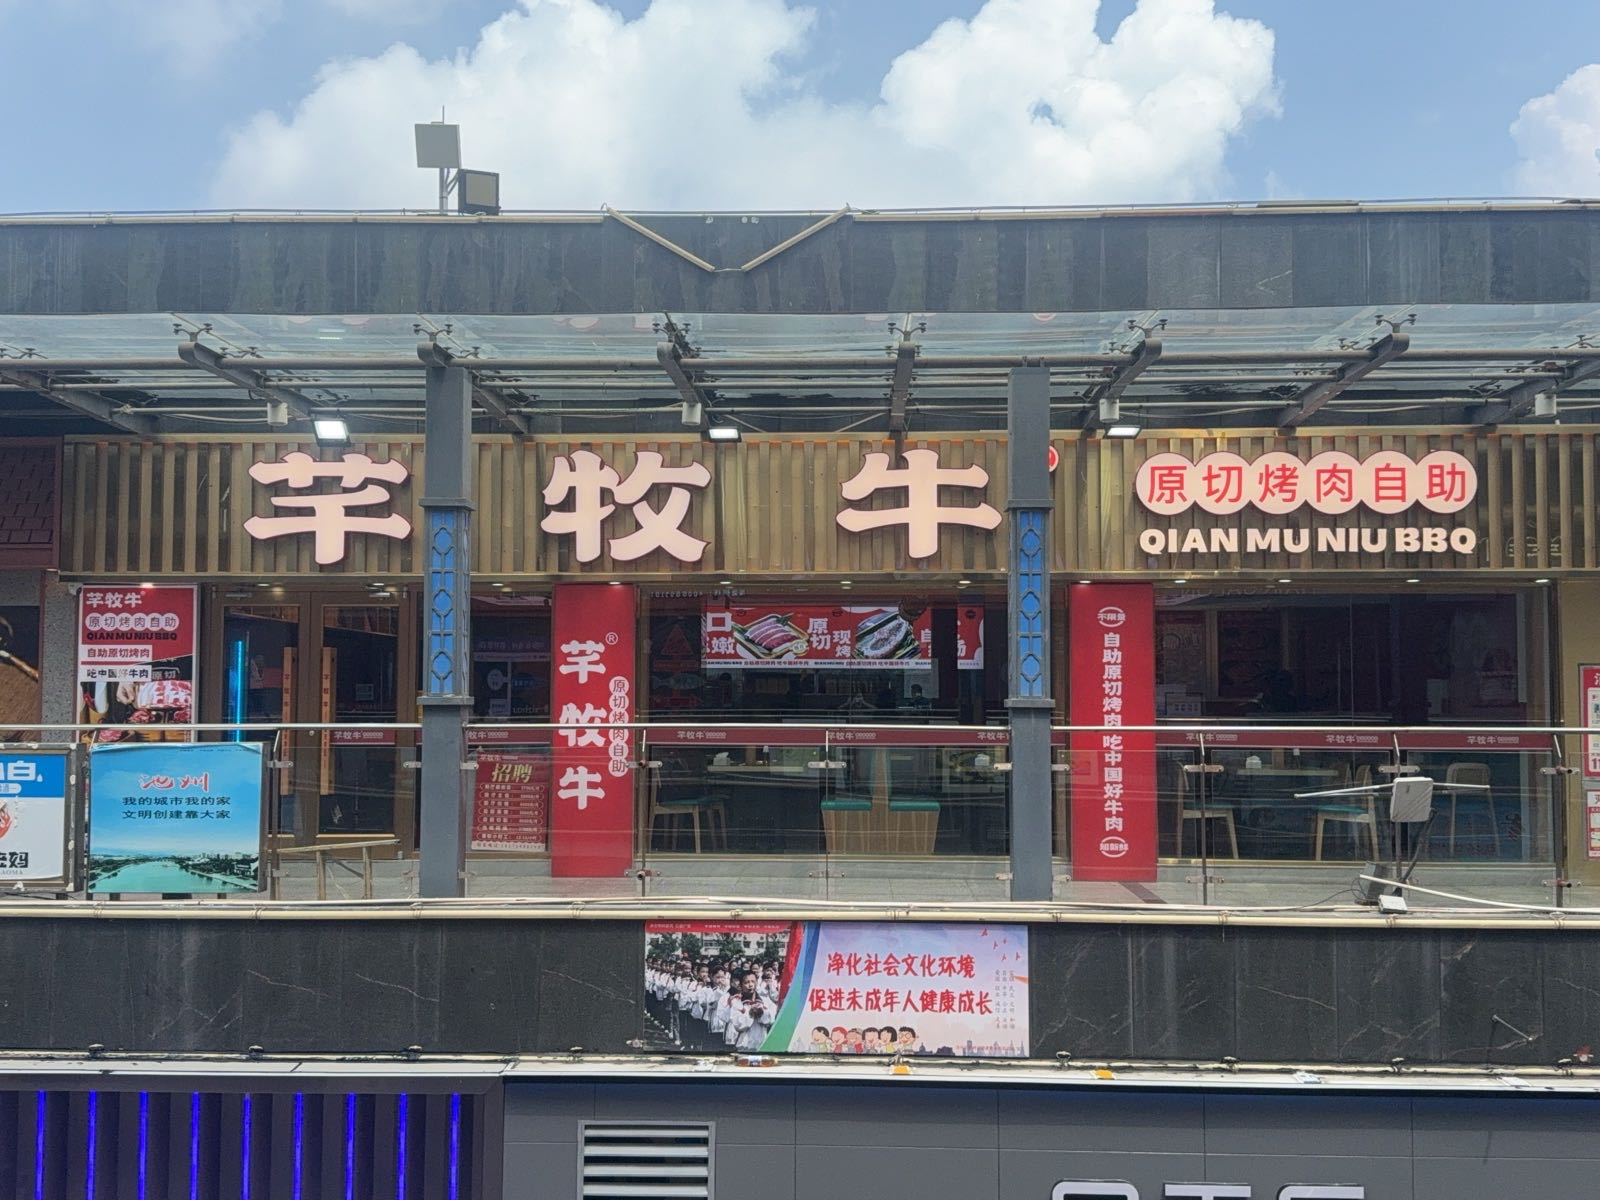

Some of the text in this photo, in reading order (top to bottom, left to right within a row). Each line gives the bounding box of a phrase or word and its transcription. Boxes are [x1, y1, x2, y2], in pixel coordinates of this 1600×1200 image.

[1148, 462, 1468, 504] 原切烤肉自助
[243, 450, 1002, 564] 芊牧牛
[1139, 526, 1477, 555] QIAN MU NIU BBQ
[86, 592, 142, 608] 芊牧牛
[89, 616, 177, 628] 原切烤肉自助
[87, 648, 150, 658] 自助原切烤肉
[557, 640, 607, 809] 芊牧牛
[0, 760, 36, 781] 白
[491, 763, 532, 783] 招聘
[138, 773, 209, 792] 池州
[122, 796, 231, 806] 我的城市我的家
[122, 810, 231, 819] 文明创建靠大家
[827, 953, 976, 978] 净化社会文化环境
[809, 989, 993, 1015] 促进未成年人健康成长
